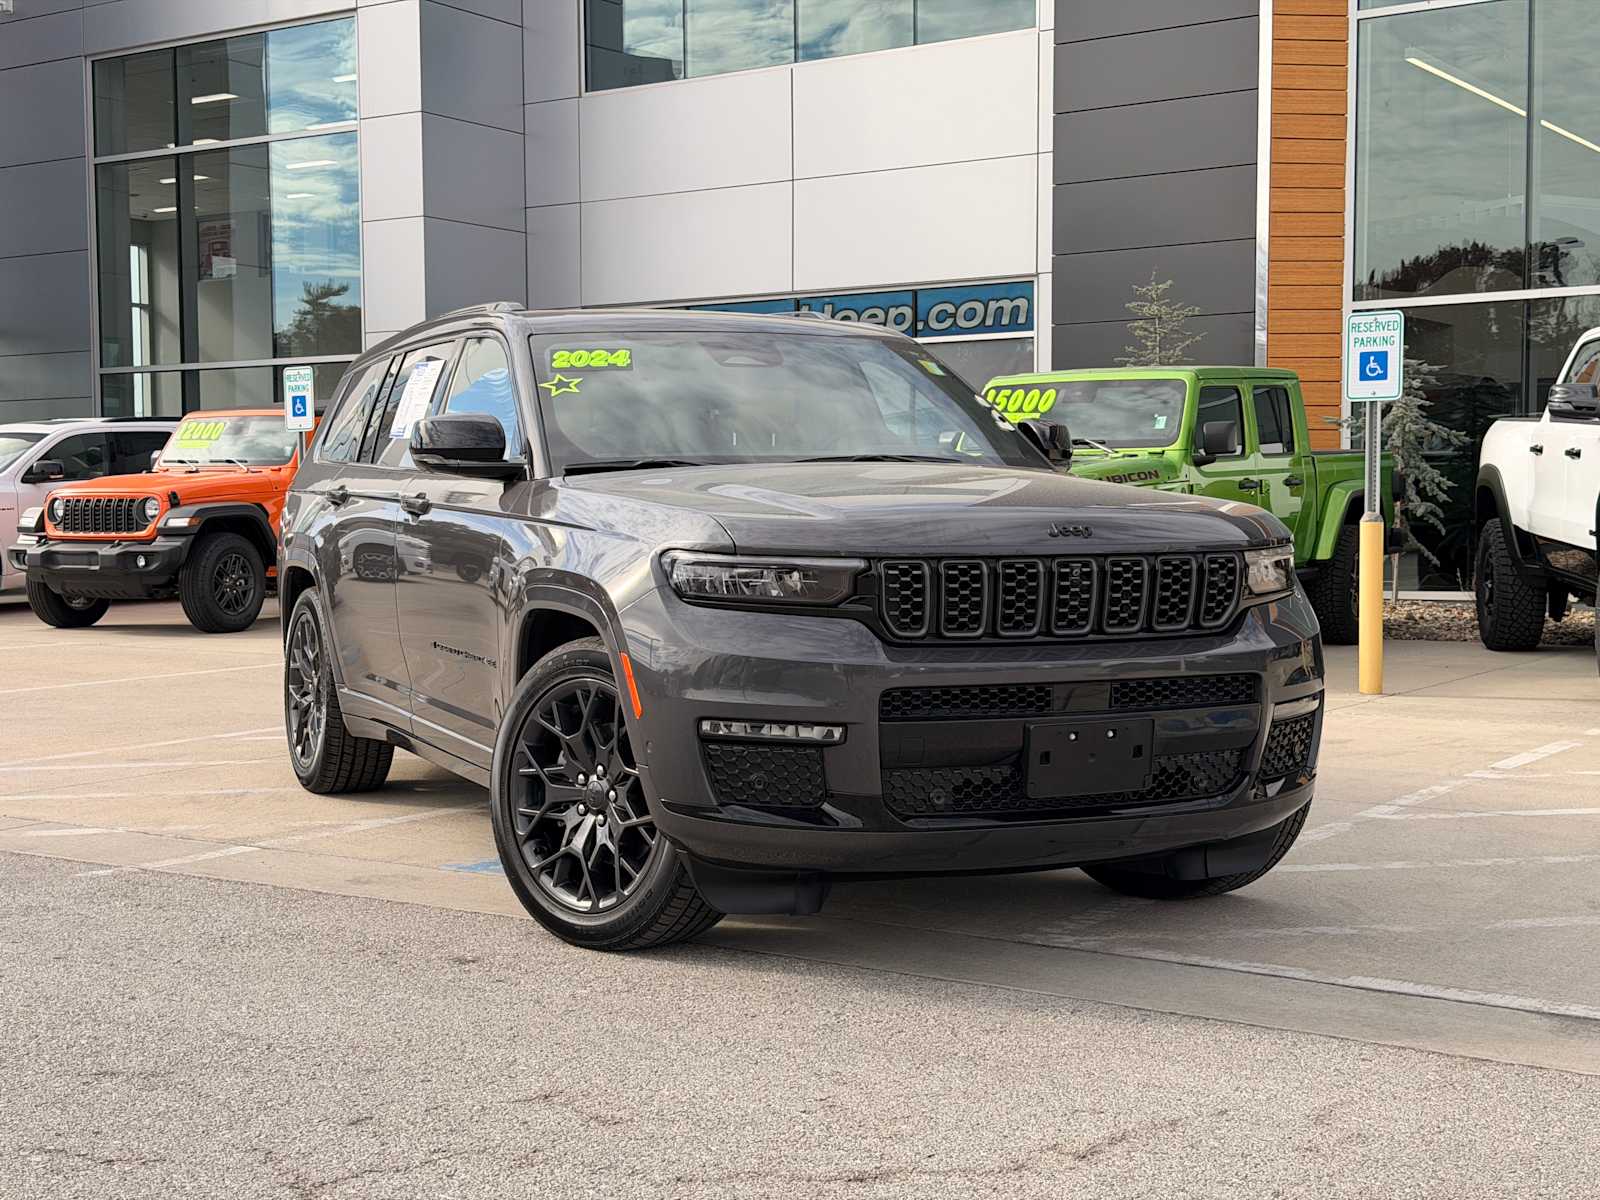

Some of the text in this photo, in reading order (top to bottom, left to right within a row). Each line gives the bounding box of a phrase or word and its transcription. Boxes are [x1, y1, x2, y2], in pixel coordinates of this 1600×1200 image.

[1351, 320, 1399, 333] RESERVED
[1353, 335, 1395, 348] PARKING
[551, 349, 632, 369] 2024
[1098, 469, 1160, 484] BICON
[1047, 521, 1093, 539] Jeep
